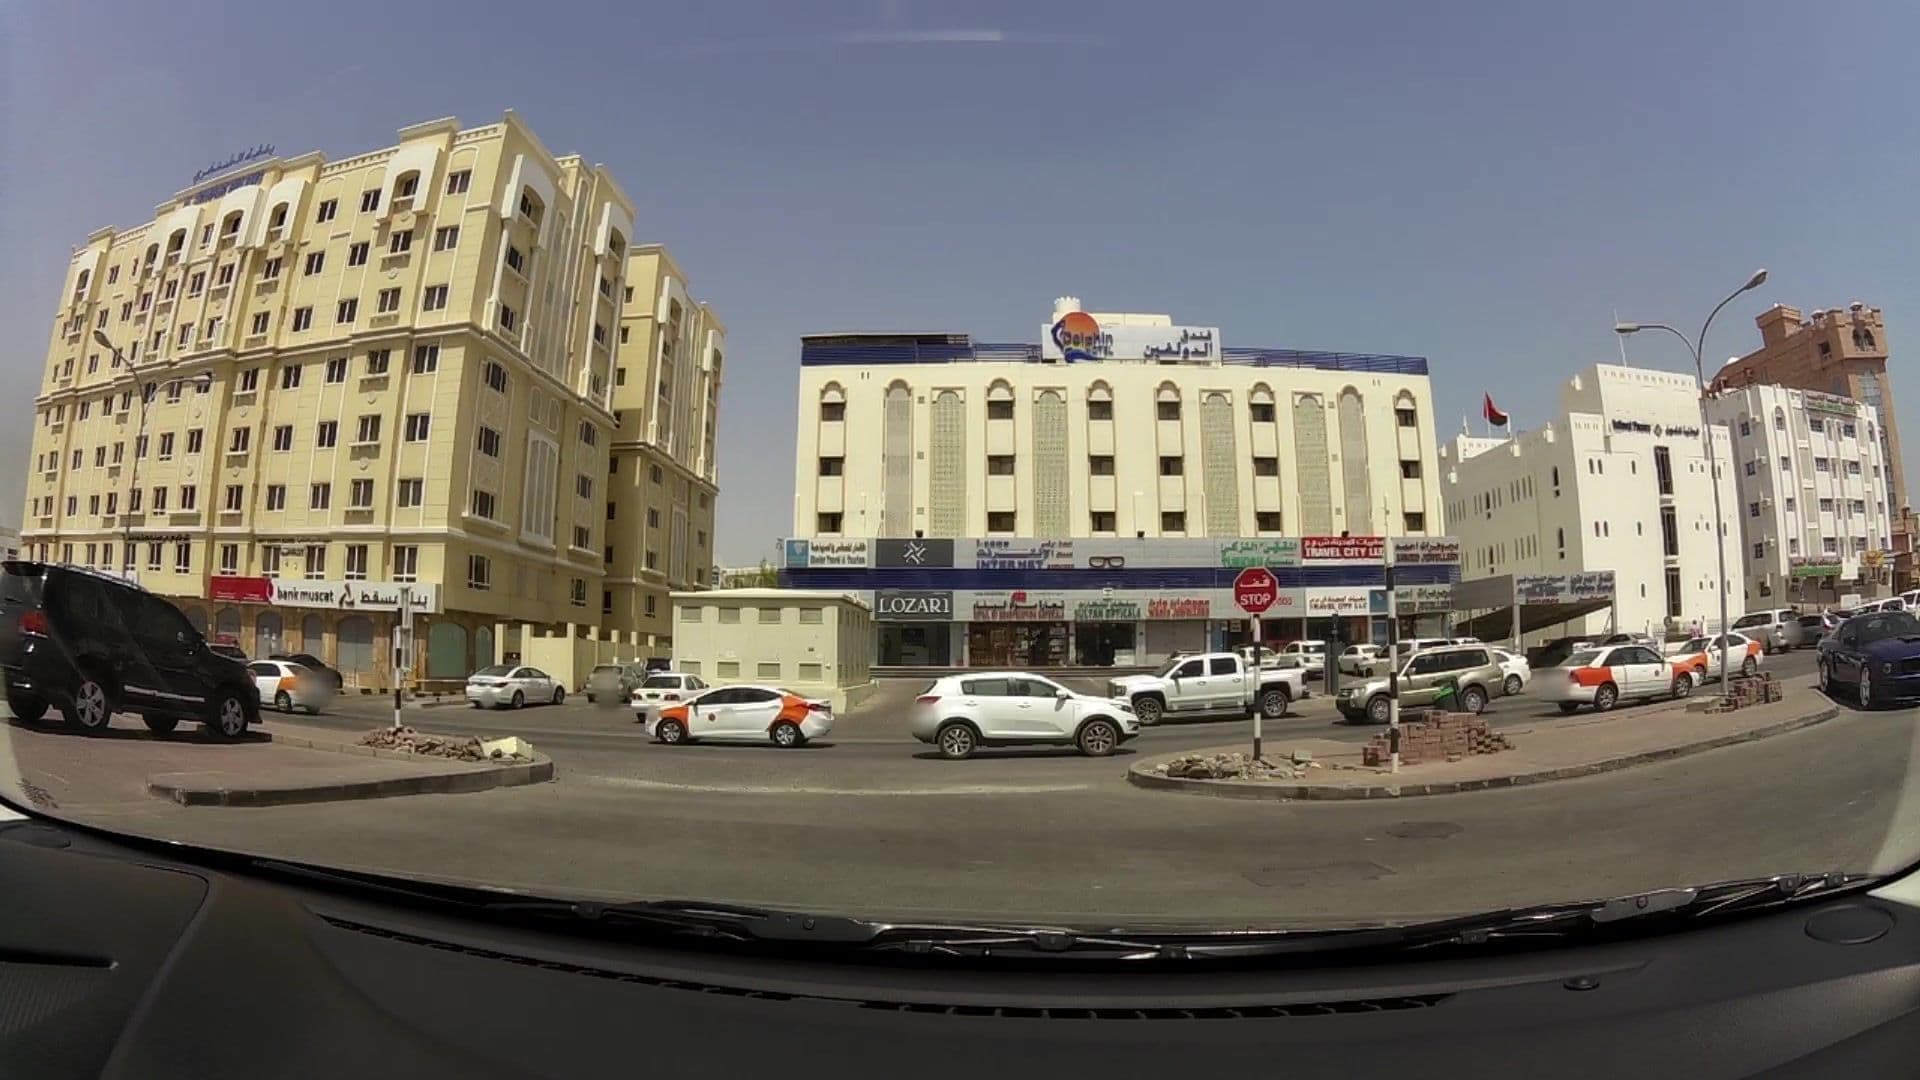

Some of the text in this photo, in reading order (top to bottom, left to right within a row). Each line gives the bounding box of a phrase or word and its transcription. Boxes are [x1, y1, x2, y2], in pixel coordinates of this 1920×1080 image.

[1305, 547, 1341, 558] TRAVEL
[1343, 547, 1367, 557] CITY
[1240, 574, 1270, 588] قف
[277, 586, 298, 601] bank
[300, 589, 335, 602] muscat
[1240, 593, 1271, 606] STOP
[877, 597, 950, 613] LOZARI
[1309, 602, 1335, 610] TRAVEL
[1337, 602, 1353, 610] CITY
